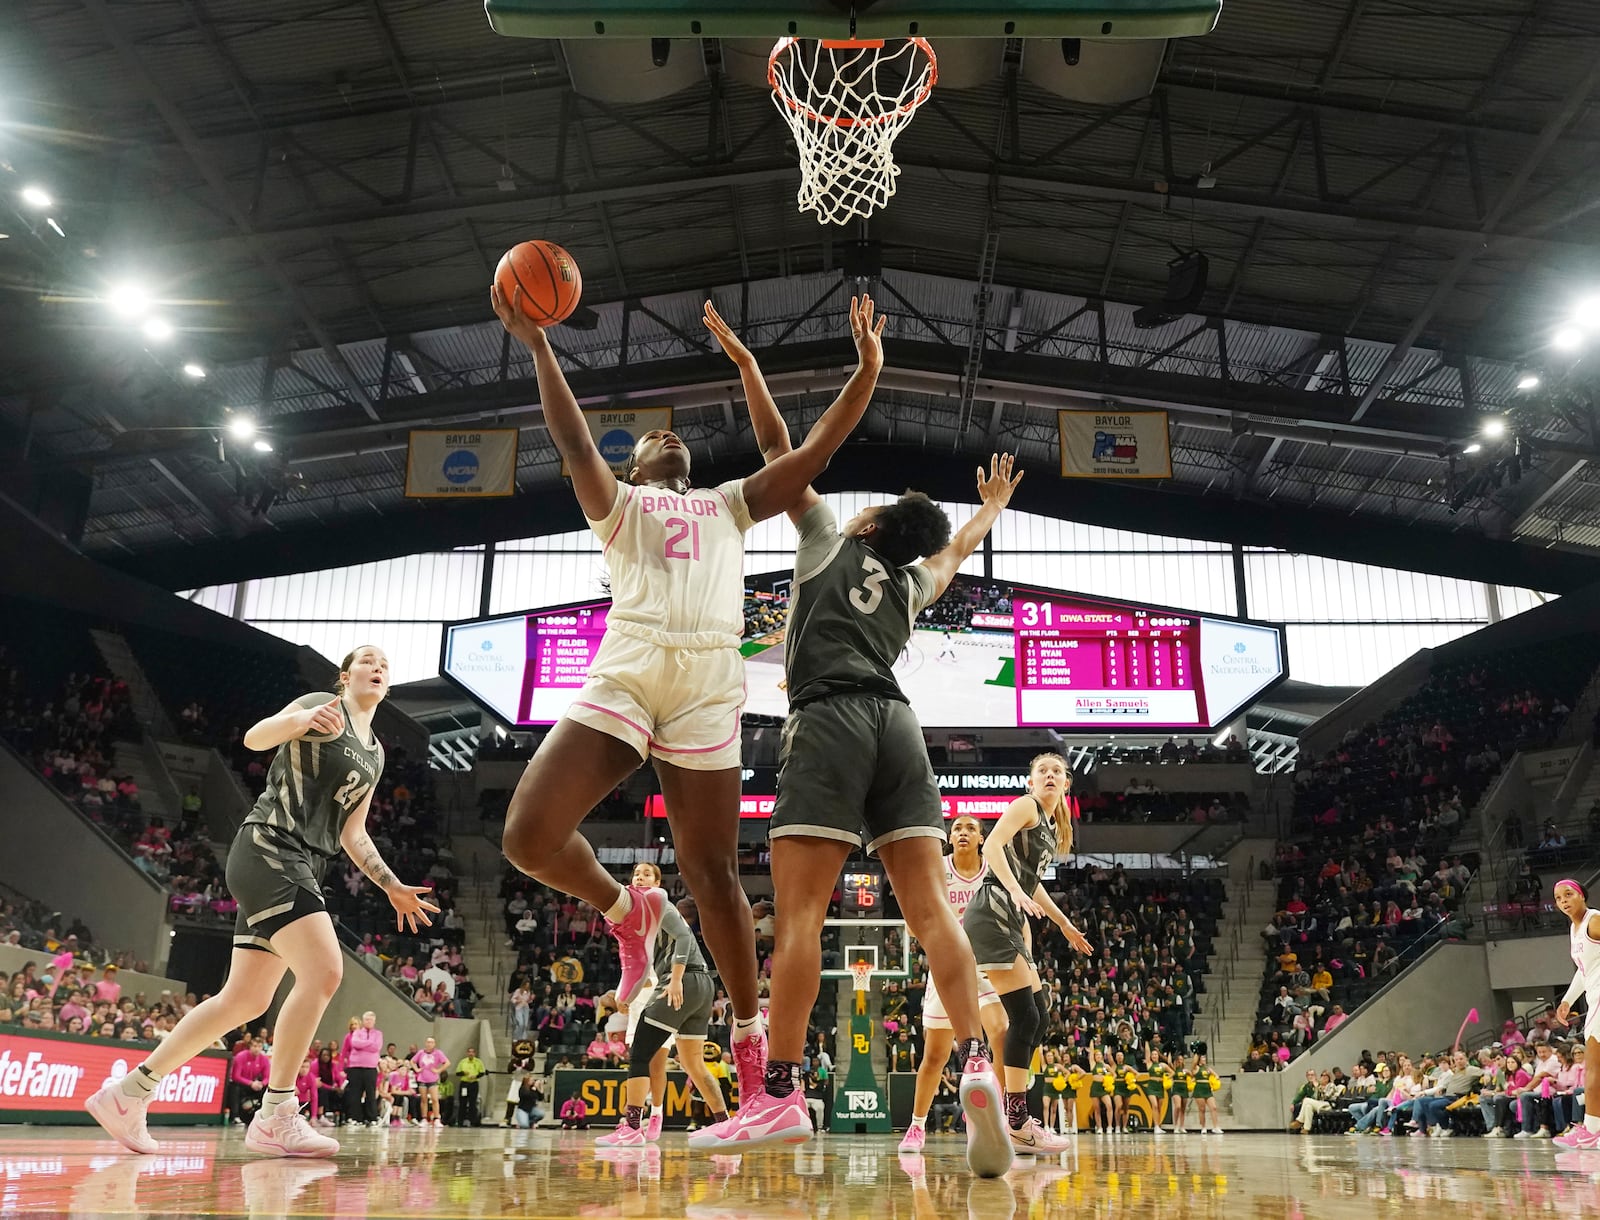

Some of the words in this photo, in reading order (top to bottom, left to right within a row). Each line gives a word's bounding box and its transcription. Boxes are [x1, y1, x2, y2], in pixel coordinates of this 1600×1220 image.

[600, 413, 636, 423] BAYLOR
[1095, 416, 1131, 425] BAYLOR
[446, 435, 481, 444] BAYLOR
[642, 496, 718, 517] BAYLOR
[665, 517, 700, 561] 21
[849, 555, 890, 615] 3
[1021, 602, 1053, 626] 31
[557, 639, 588, 647] FELDER
[1040, 640, 1079, 648] WILLIAMS
[556, 648, 589, 656] WALKER
[1027, 649, 1036, 657] 11
[1041, 649, 1062, 657] RYAN
[1027, 658, 1037, 666] 23
[1041, 658, 1066, 666] JOENS
[1222, 655, 1257, 664] CENTRAL
[541, 666, 551, 674] 22
[1211, 665, 1250, 673] NATIONAL
[1251, 665, 1273, 673] BANK
[540, 675, 550, 683] 24
[1042, 677, 1071, 685] HARRIS
[1076, 699, 1102, 707] Allen
[1106, 699, 1149, 707] Samuels
[962, 774, 1031, 788] INSURAN
[333, 770, 370, 811] 24
[858, 888, 874, 906] 16
[853, 1034, 869, 1054] BU
